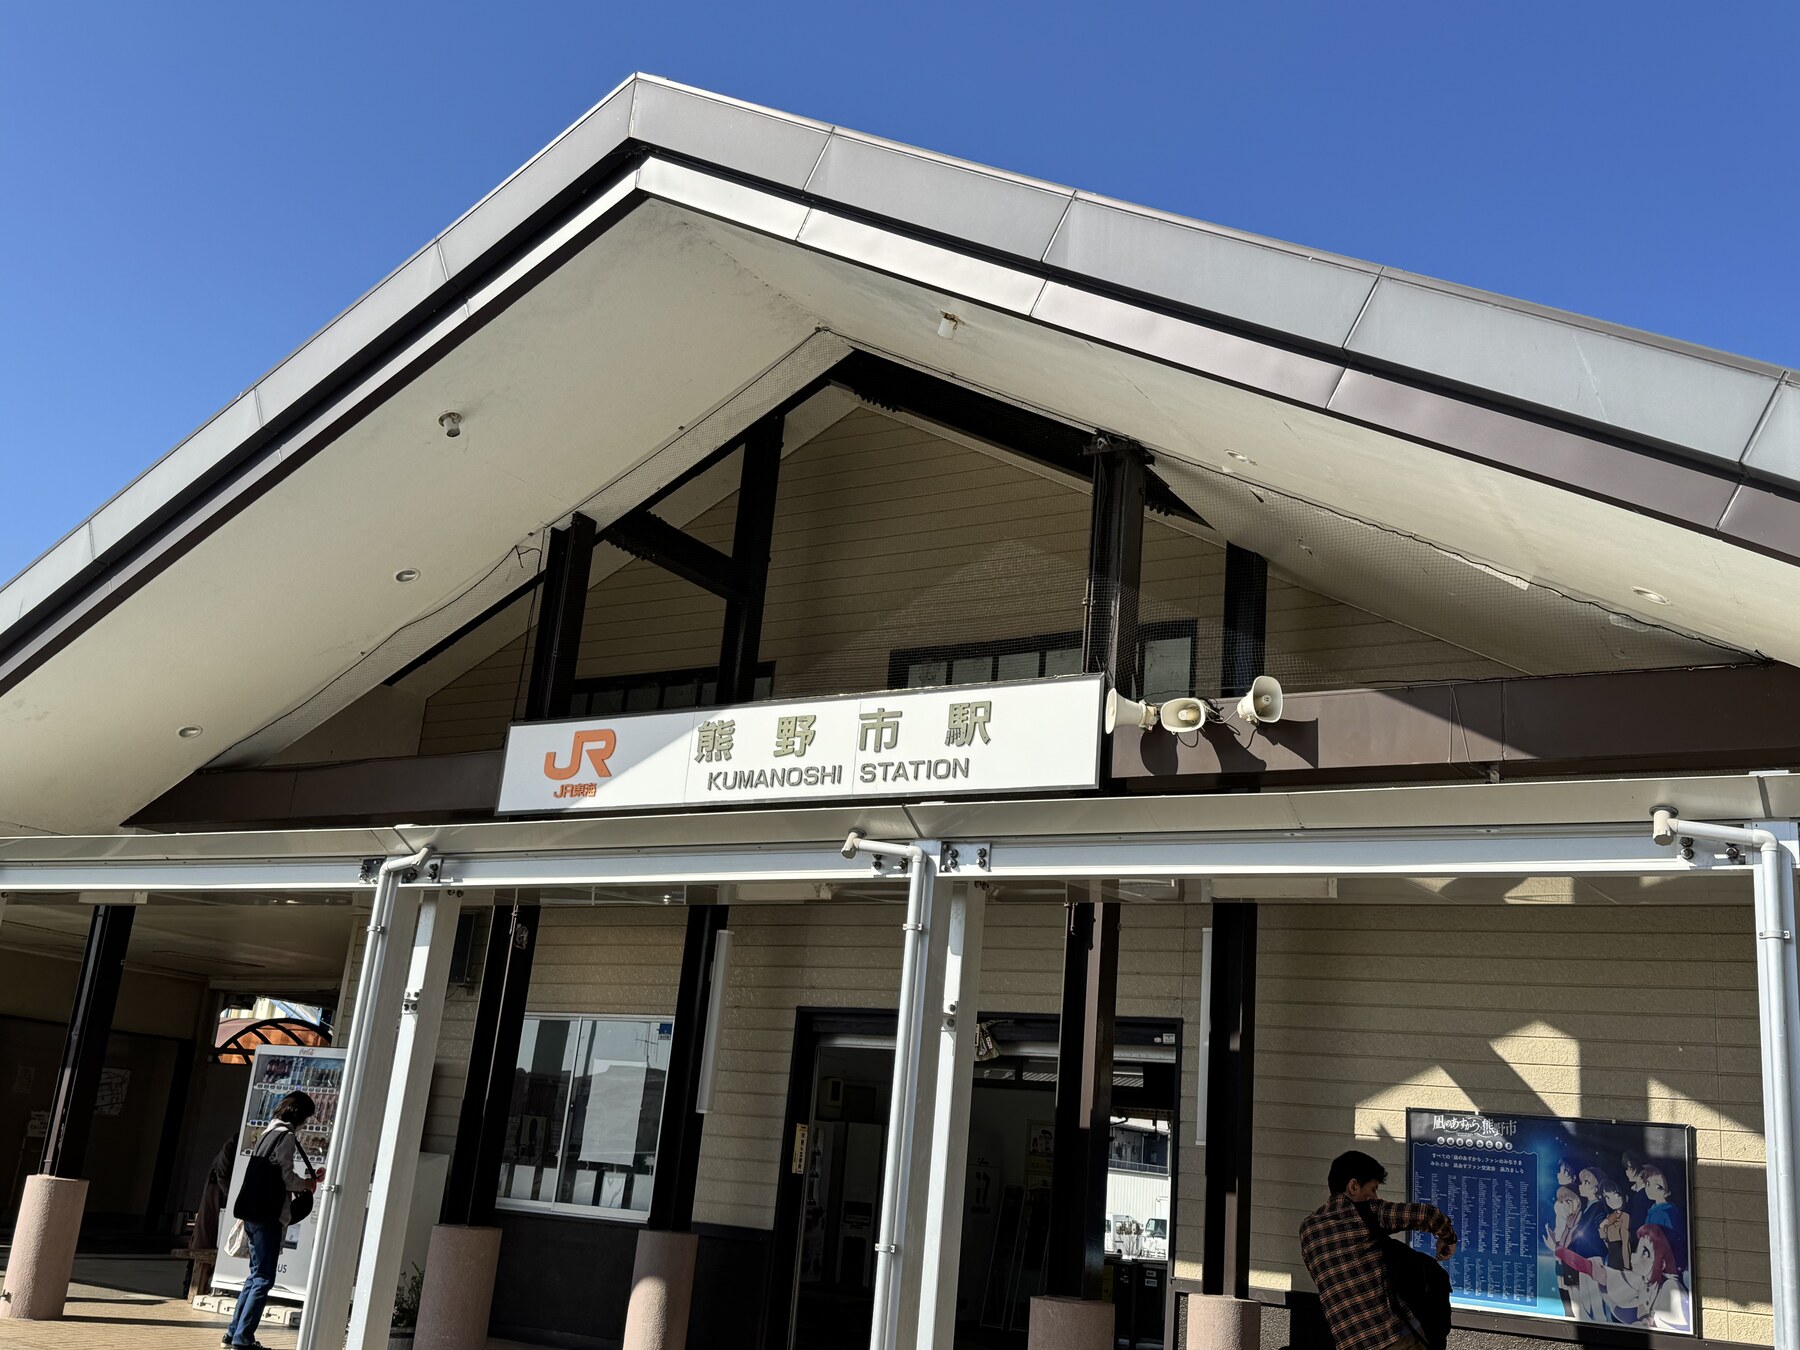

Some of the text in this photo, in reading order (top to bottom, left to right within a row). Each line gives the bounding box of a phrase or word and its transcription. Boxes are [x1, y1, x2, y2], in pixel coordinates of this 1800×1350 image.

[694, 700, 992, 764] 熊野市駅
[543, 728, 617, 781] JR
[707, 757, 970, 791] KUMANOSHI STATION
[553, 783, 597, 798] JR東海
